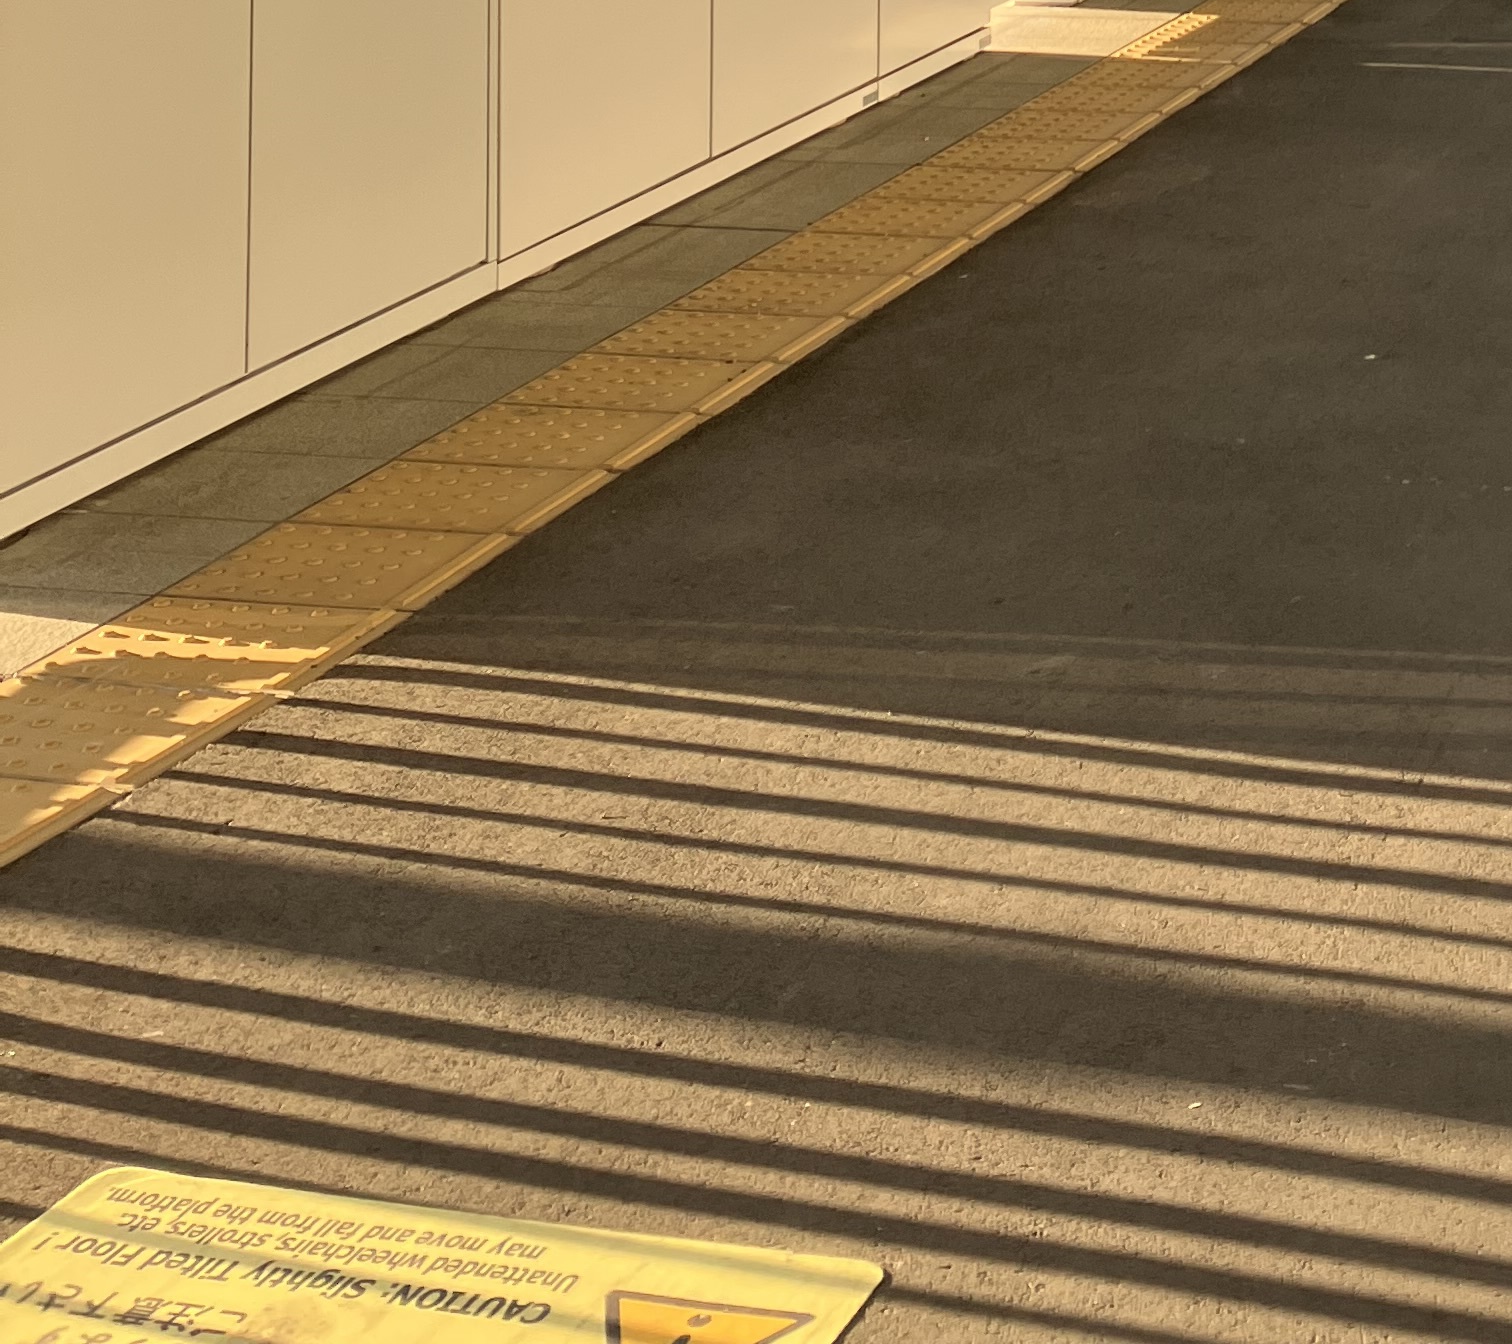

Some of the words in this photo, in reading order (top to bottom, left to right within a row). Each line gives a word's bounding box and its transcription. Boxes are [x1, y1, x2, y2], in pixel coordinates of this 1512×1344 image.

[107, 1186, 219, 1214] platform.
[213, 1202, 257, 1225] the
[168, 1213, 272, 1247] strollers,
[257, 1208, 313, 1234] from
[313, 1218, 357, 1241] fall
[358, 1223, 416, 1244] and
[58, 1233, 146, 1266] Floor
[275, 1231, 416, 1271] wheelchairs,
[416, 1231, 488, 1254] move
[491, 1236, 548, 1260] may
[137, 1247, 239, 1281] Tilted
[422, 1257, 579, 1293] Unattended
[240, 1260, 376, 1300] Slightly
[380, 1283, 552, 1324] CAUTION:
